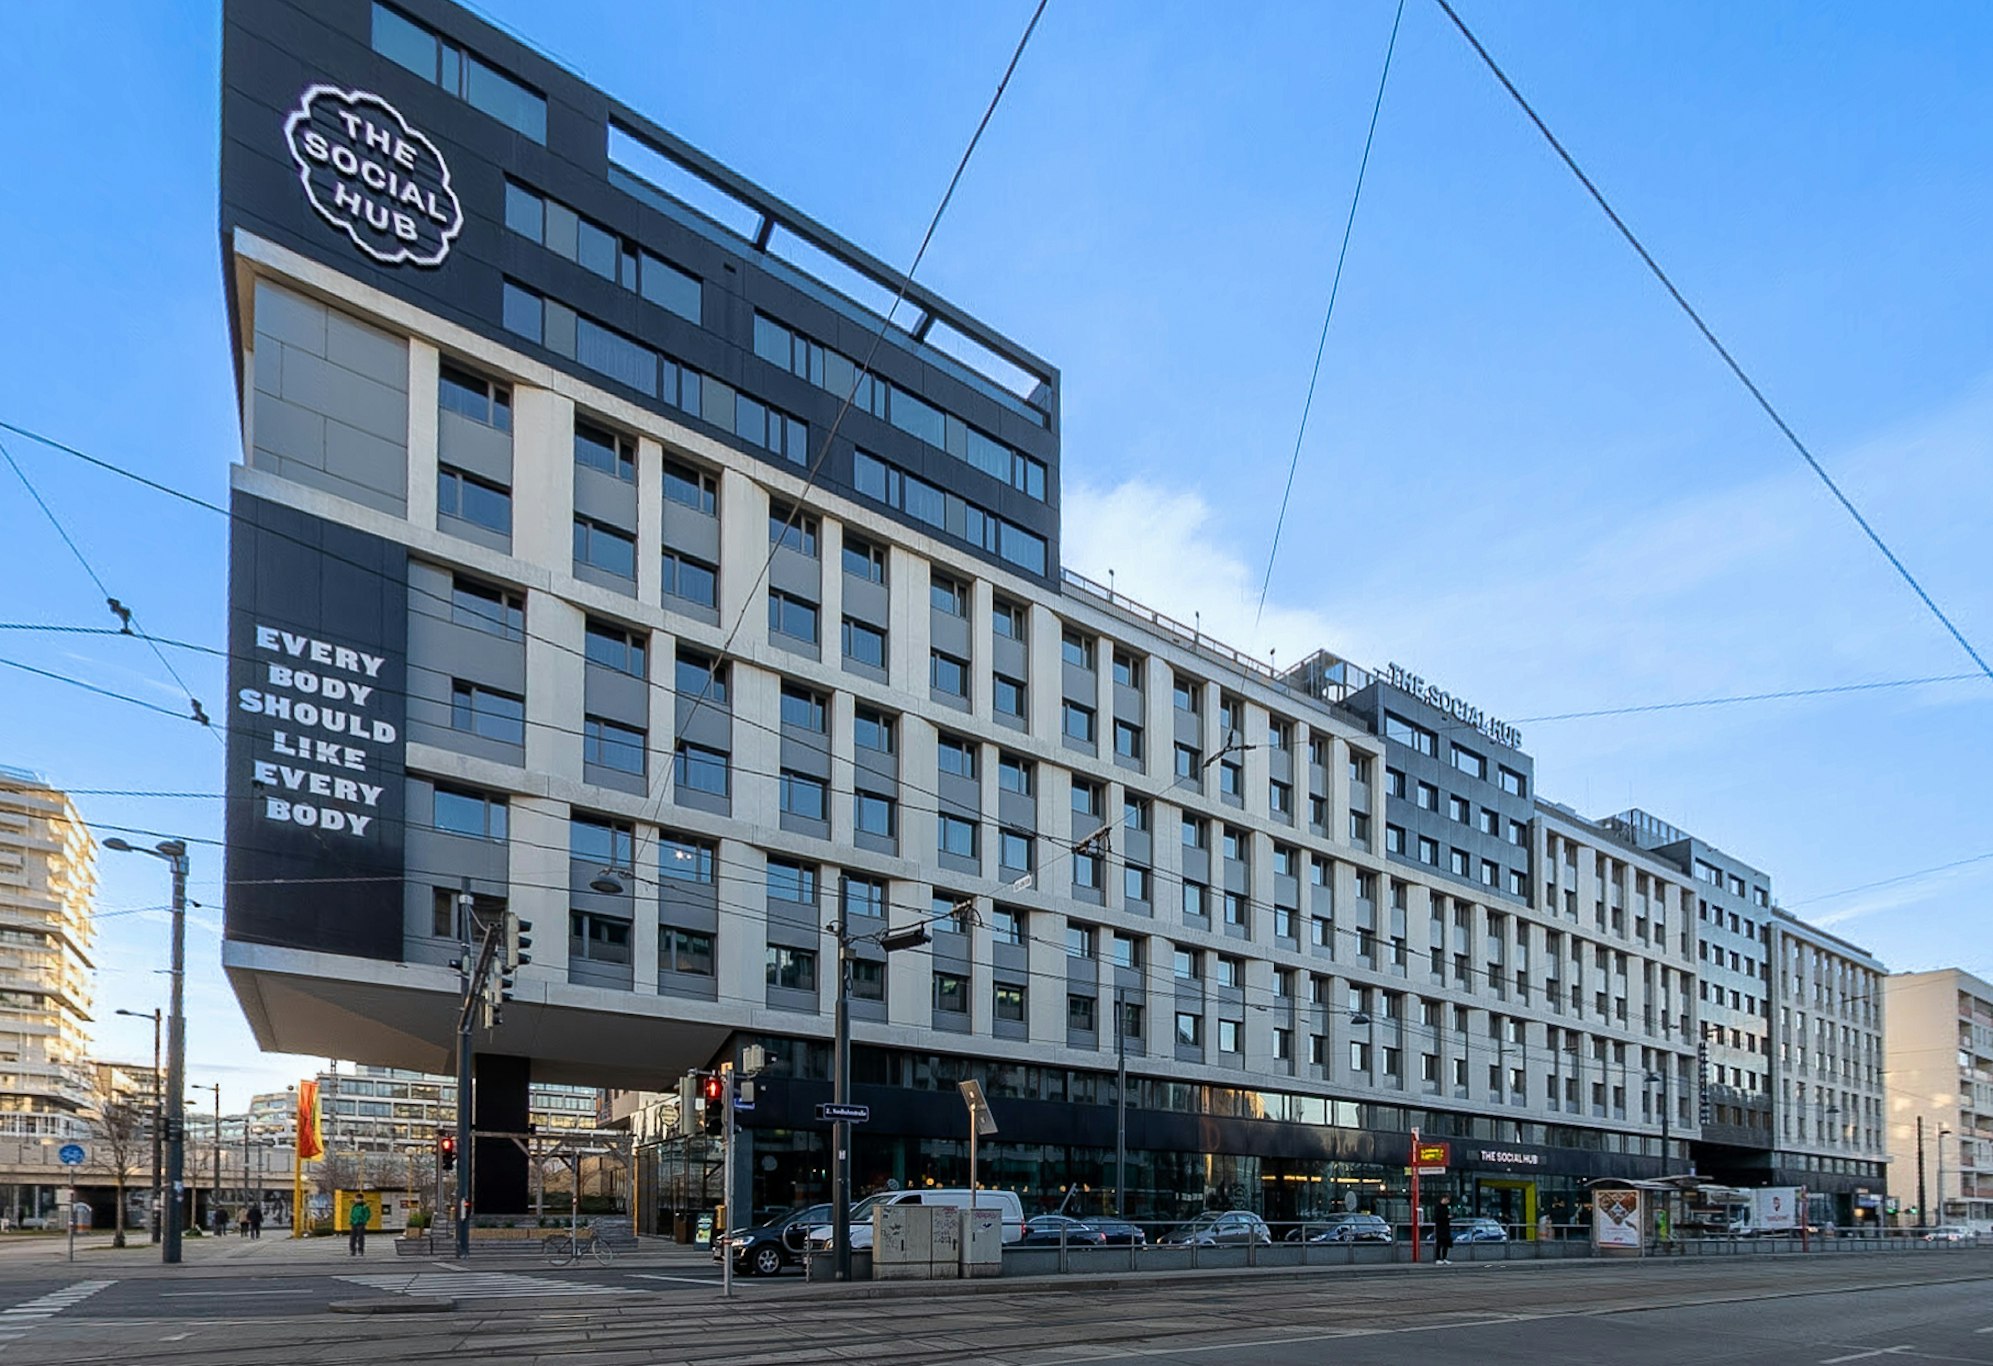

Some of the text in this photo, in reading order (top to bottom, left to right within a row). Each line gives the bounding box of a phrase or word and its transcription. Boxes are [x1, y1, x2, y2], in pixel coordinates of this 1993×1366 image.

[339, 109, 418, 170] THE
[304, 131, 448, 222] SOCIAL
[333, 181, 419, 240] HUB
[256, 624, 385, 678] EVERY
[268, 662, 373, 706] BODY
[1389, 661, 1523, 748] THE SOCIAL HUB
[239, 689, 396, 744] SHOULD
[273, 730, 366, 771] LIKE
[254, 760, 384, 806] EVERY
[265, 796, 372, 837] BODY
[1481, 1150, 1539, 1166] THE SOCIAL HUB
